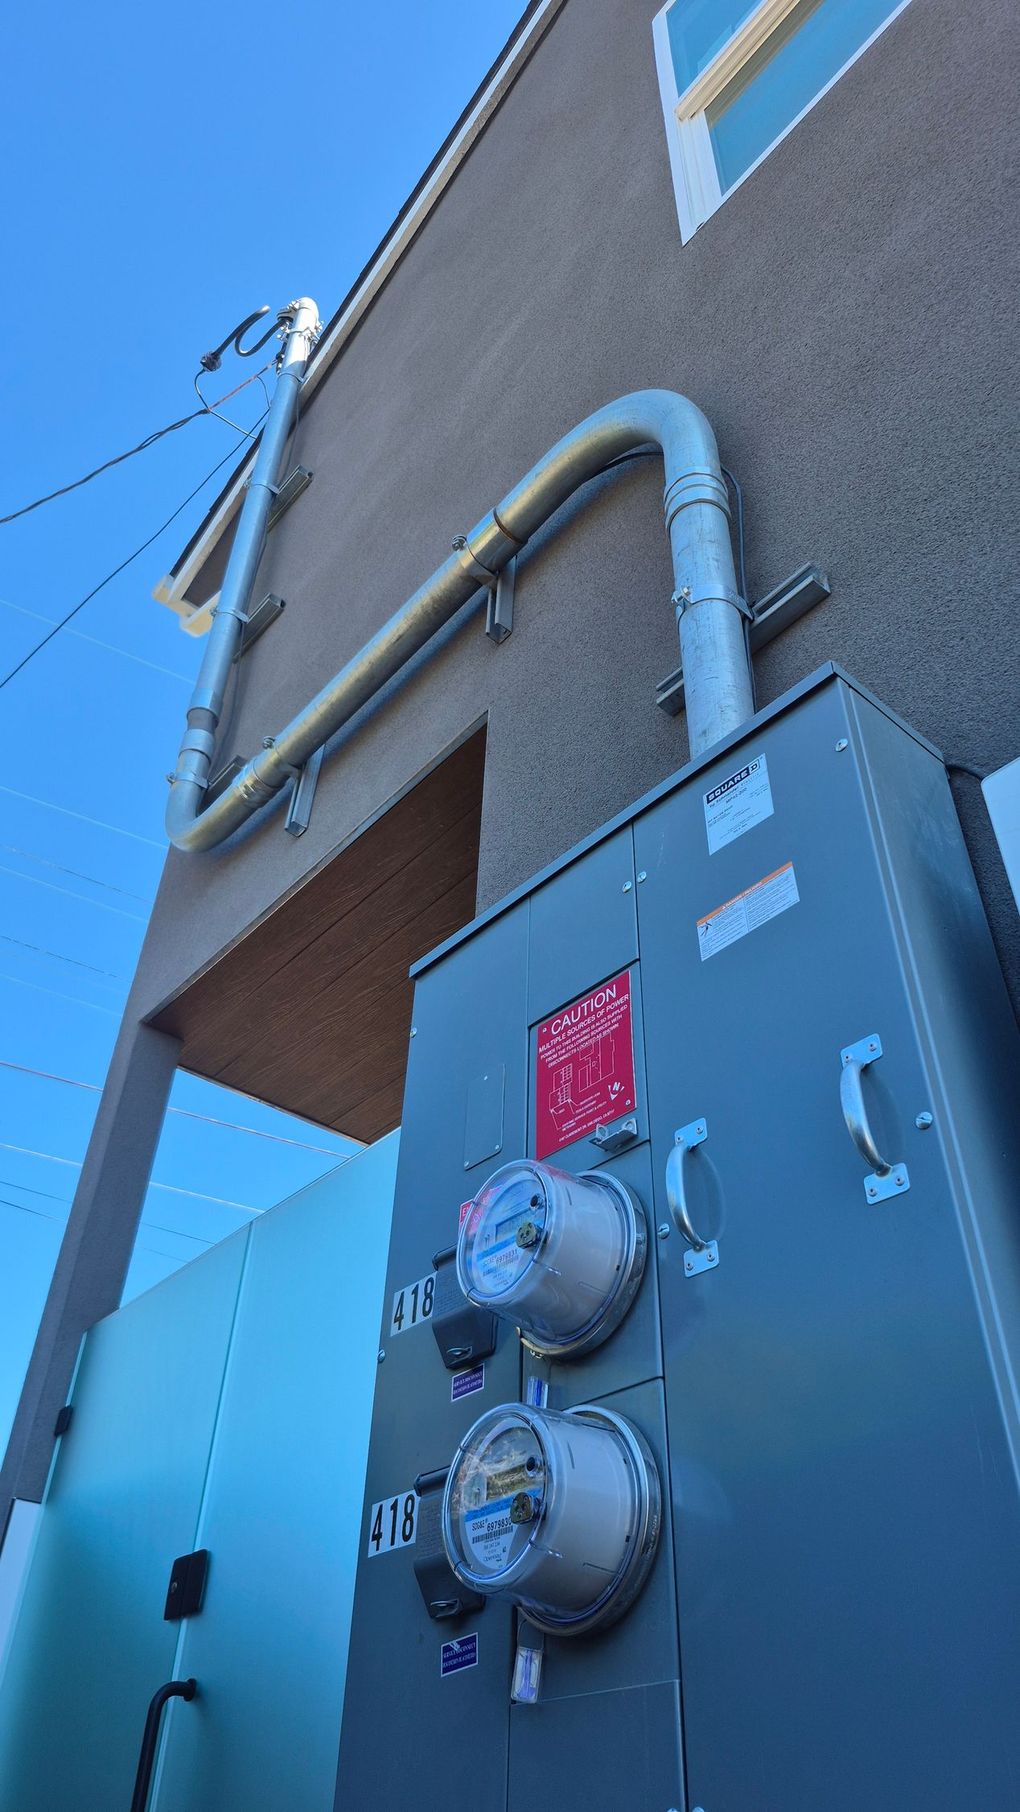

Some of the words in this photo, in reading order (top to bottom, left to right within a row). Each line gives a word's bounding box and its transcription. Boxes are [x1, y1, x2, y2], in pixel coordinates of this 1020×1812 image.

[708, 769, 748, 801] SQUARE
[750, 763, 758, 772] D
[538, 1032, 566, 1053] MULTIPLE
[567, 1015, 596, 1037] SOURCES
[596, 1008, 606, 1019] OF
[606, 993, 629, 1012] POWER
[551, 984, 617, 1035] CAUTION
[571, 1027, 591, 1041] BUILDING
[596, 1017, 607, 1028] ALSO
[606, 1004, 628, 1020] SUPPLIED
[566, 1034, 590, 1051] FOLLOWING
[590, 1021, 611, 1037] SOURCES
[611, 1014, 623, 1024] WITH
[612, 1081, 621, 1092] N
[393, 1276, 435, 1331] 418
[371, 1493, 416, 1552] 418
